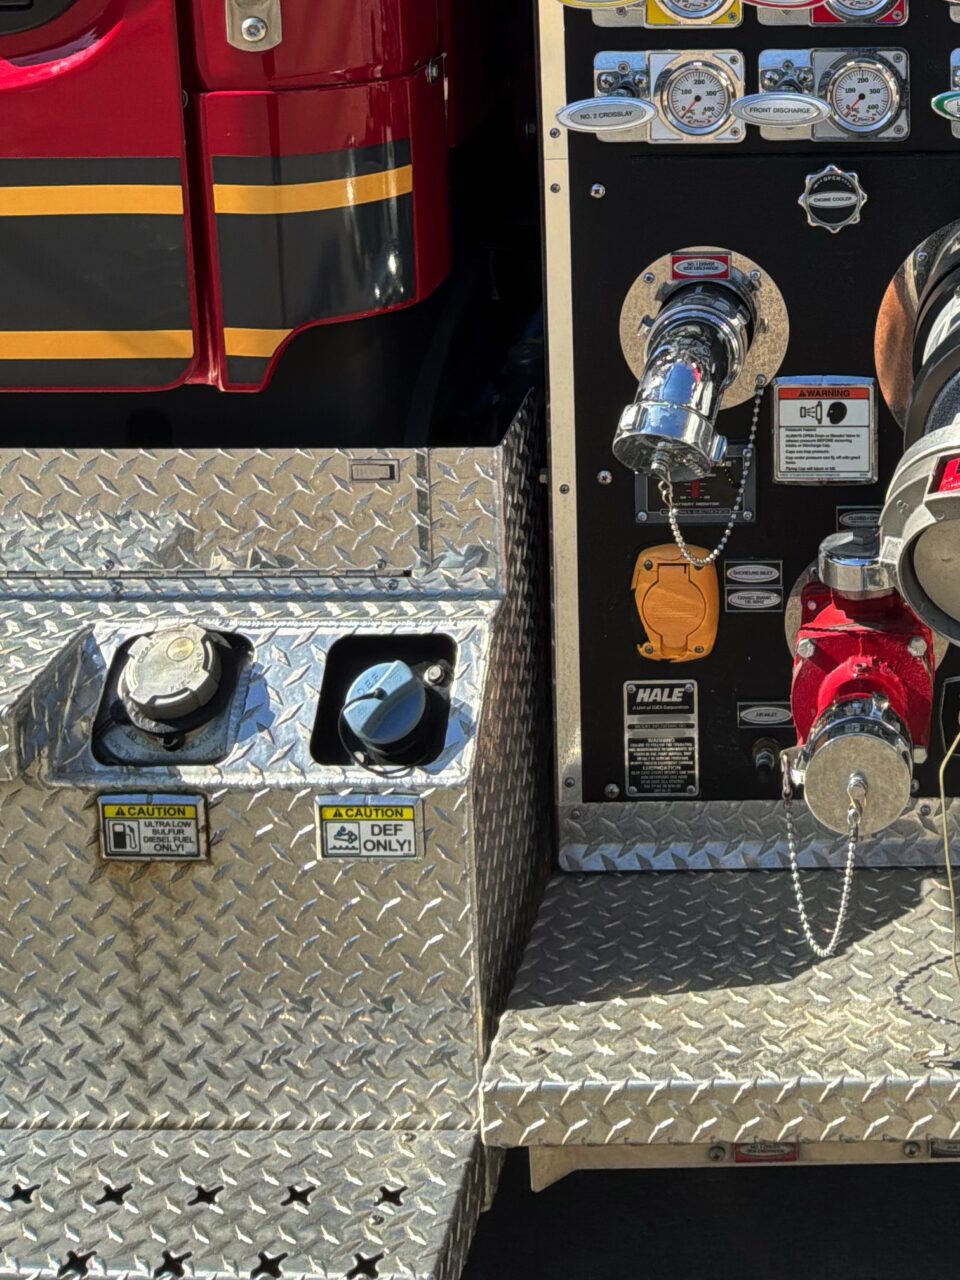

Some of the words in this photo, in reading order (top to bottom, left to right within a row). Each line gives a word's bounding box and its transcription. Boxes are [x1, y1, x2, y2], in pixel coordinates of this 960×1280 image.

[636, 688, 684, 702] HALE
[128, 807, 186, 816] CAUTION
[345, 808, 403, 817] CAUTION
[371, 824, 403, 836] DEF
[154, 844, 184, 852] ONLY!
[363, 840, 411, 852] ONLY!
